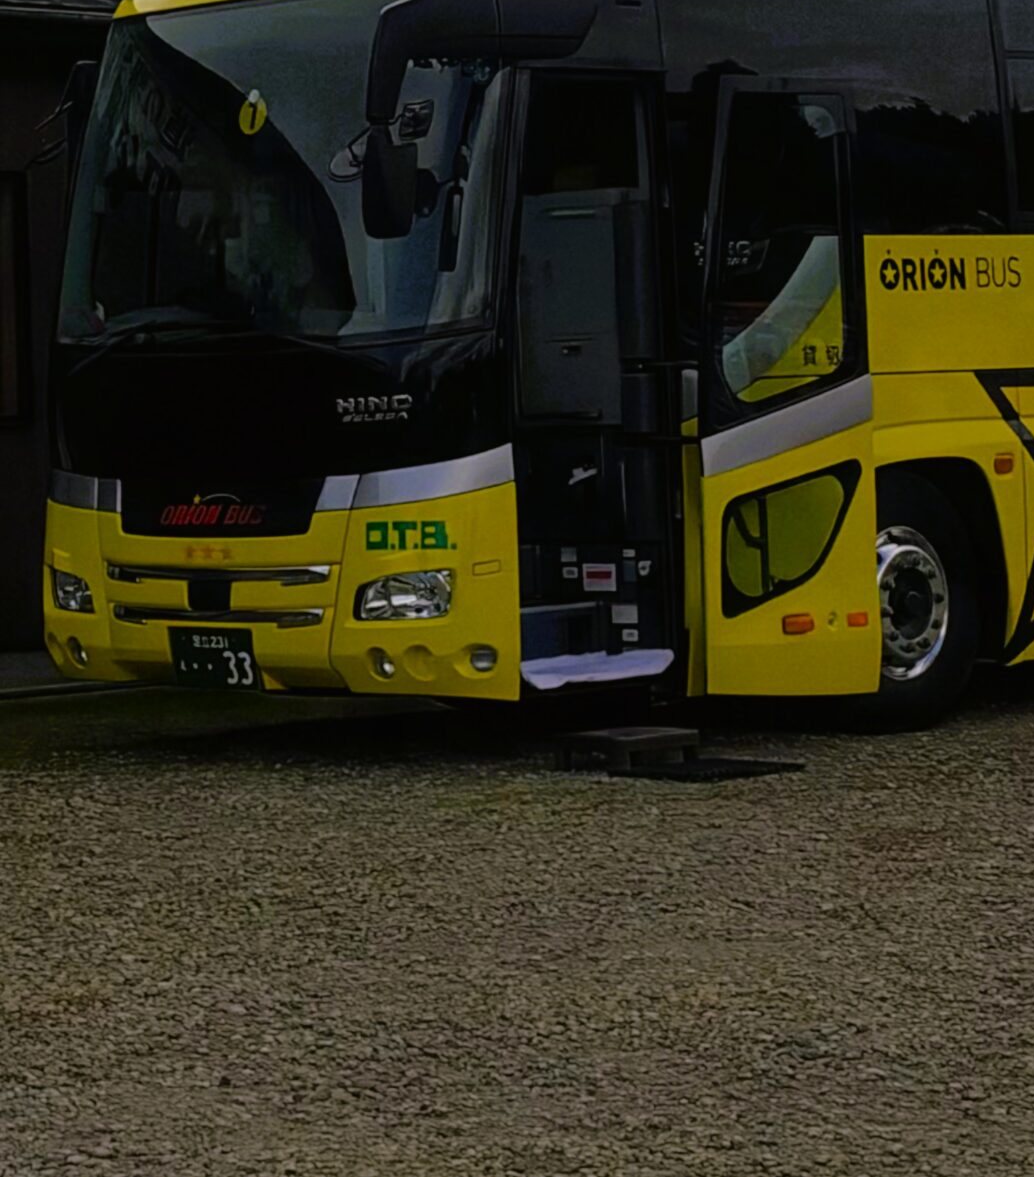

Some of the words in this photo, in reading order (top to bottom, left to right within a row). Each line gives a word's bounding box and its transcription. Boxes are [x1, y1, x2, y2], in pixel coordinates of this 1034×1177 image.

[879, 256, 967, 291] ORION
[976, 256, 1021, 288] BUS
[336, 394, 412, 412] HINO
[161, 504, 221, 525] ORION
[224, 504, 266, 525] BUS
